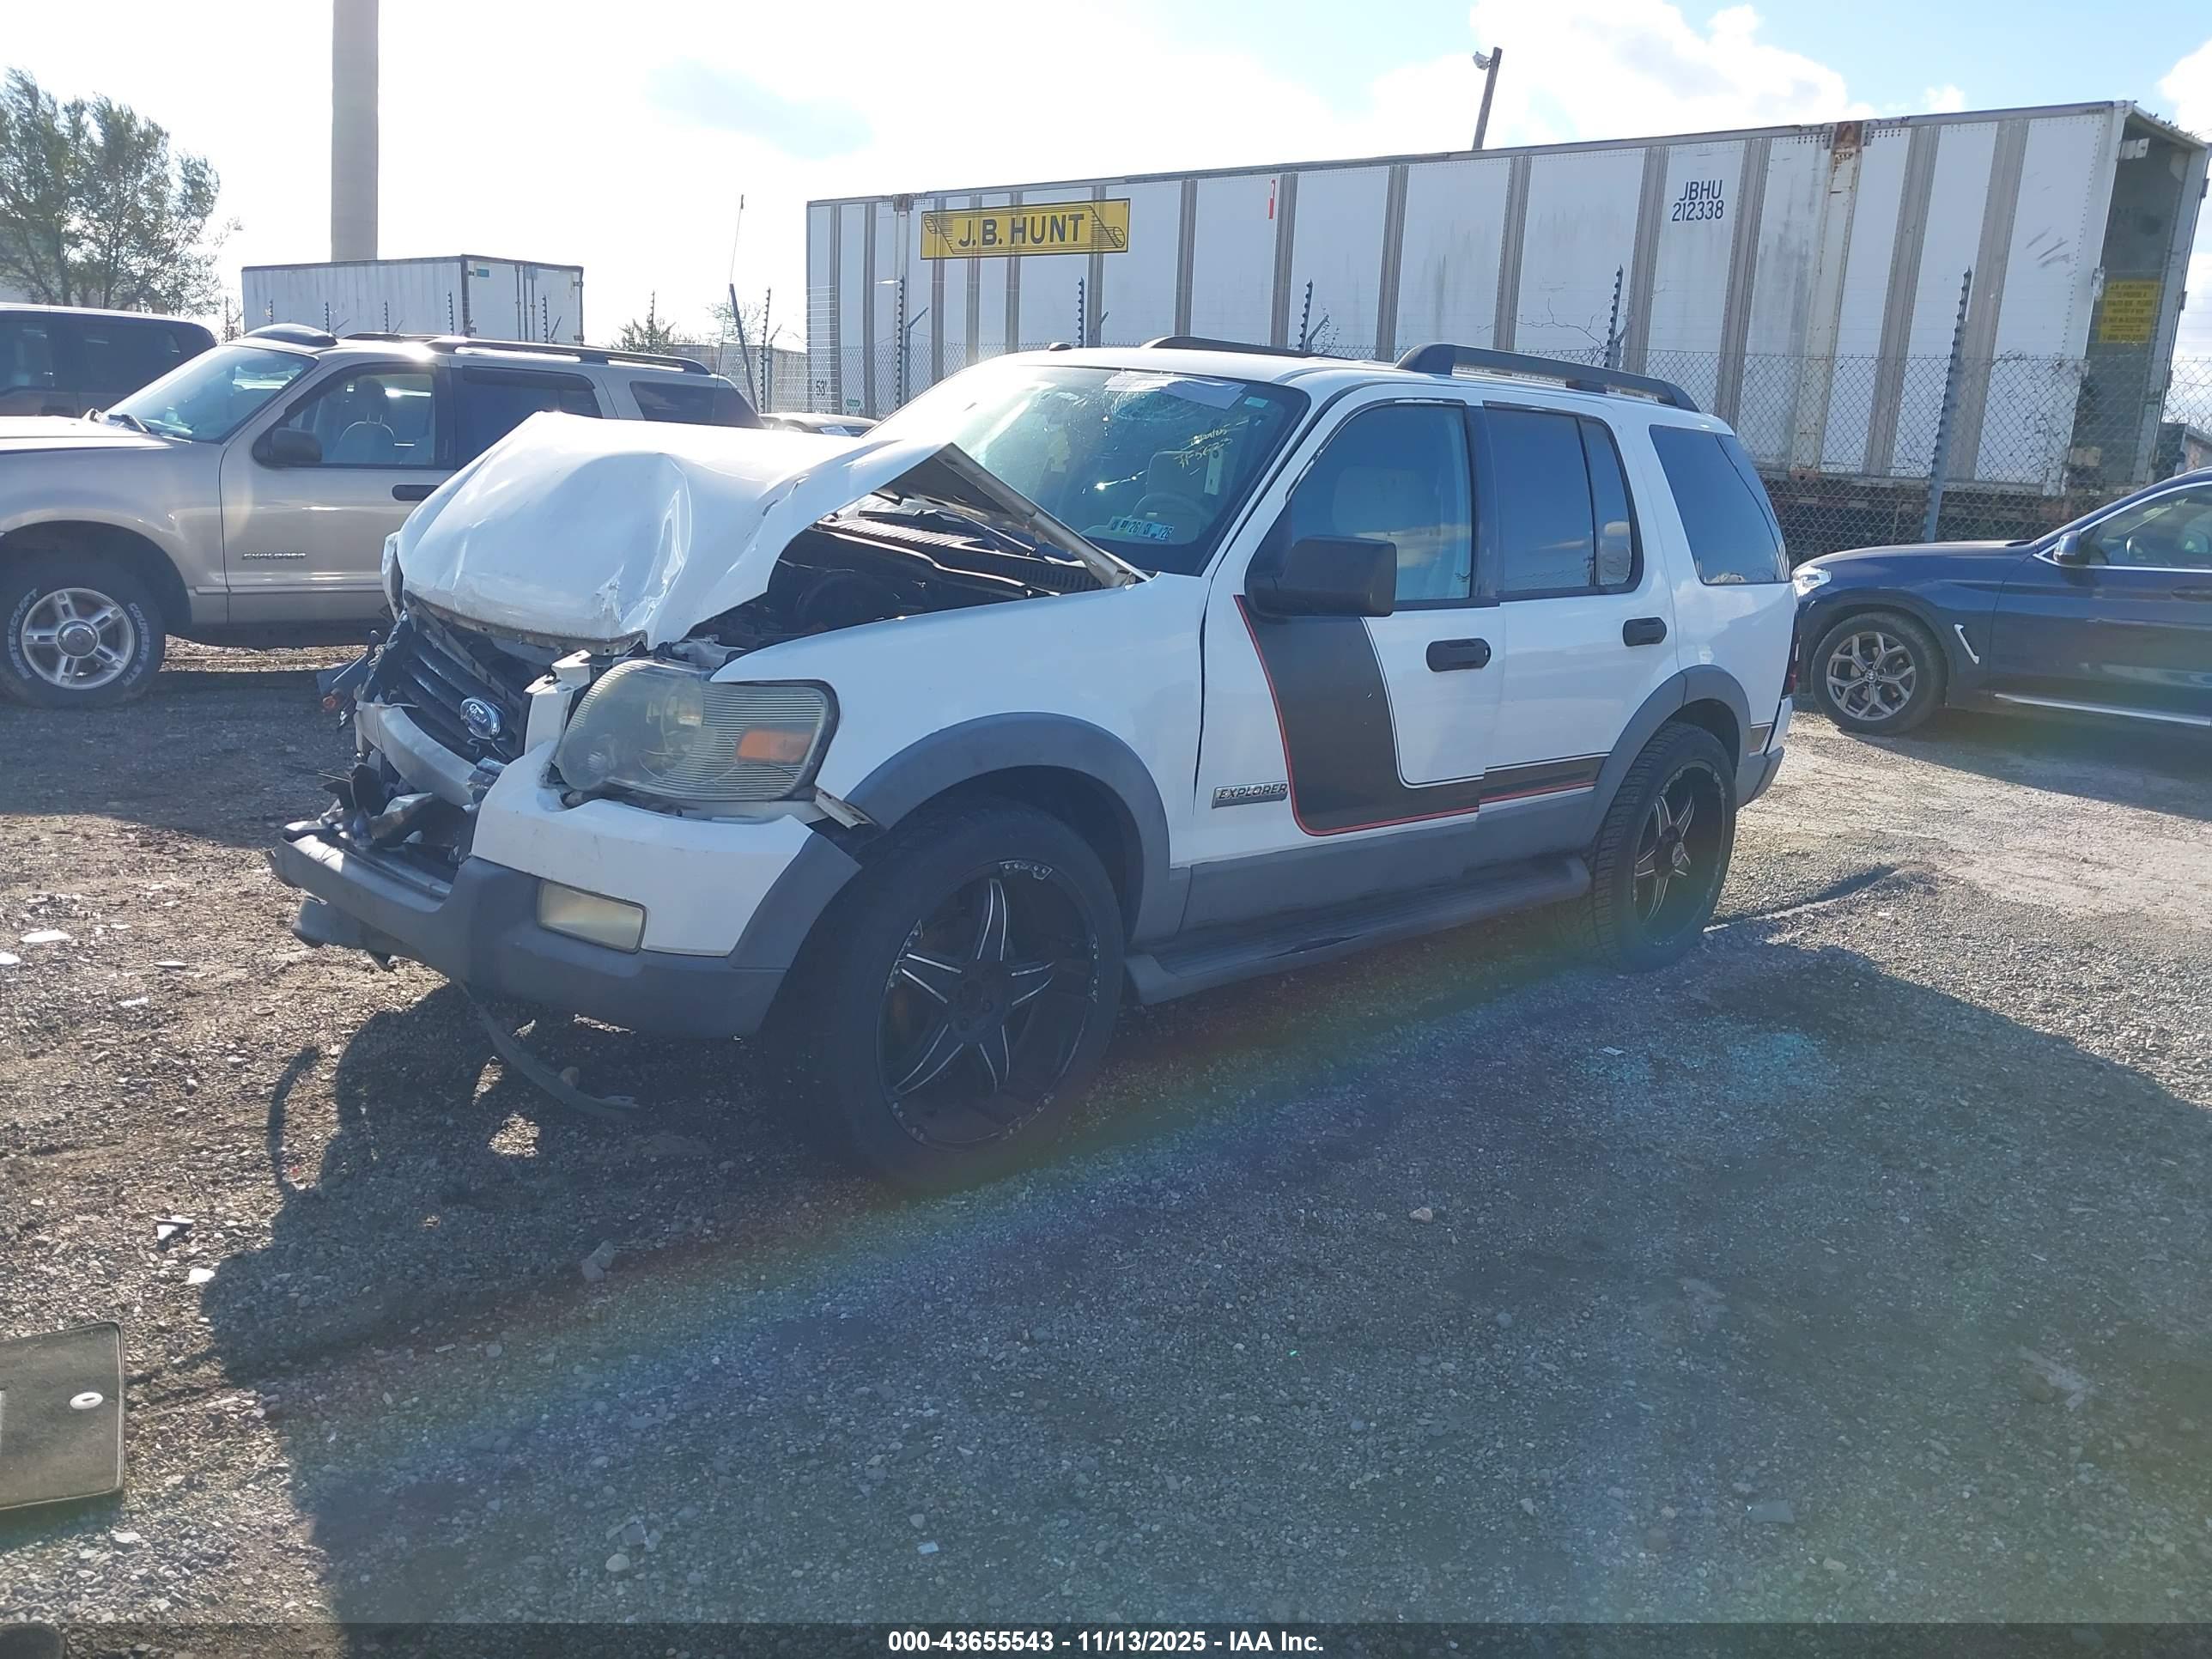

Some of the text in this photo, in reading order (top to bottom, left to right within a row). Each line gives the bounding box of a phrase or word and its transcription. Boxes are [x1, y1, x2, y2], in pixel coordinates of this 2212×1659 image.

[1679, 179, 1723, 201] JBHU
[1672, 200, 1724, 222] 212338
[958, 214, 1085, 247] J.B. HUNT
[242, 552, 307, 561] EXPLORER
[466, 702, 488, 725] Ford
[1218, 783, 1288, 799] EXPLORER
